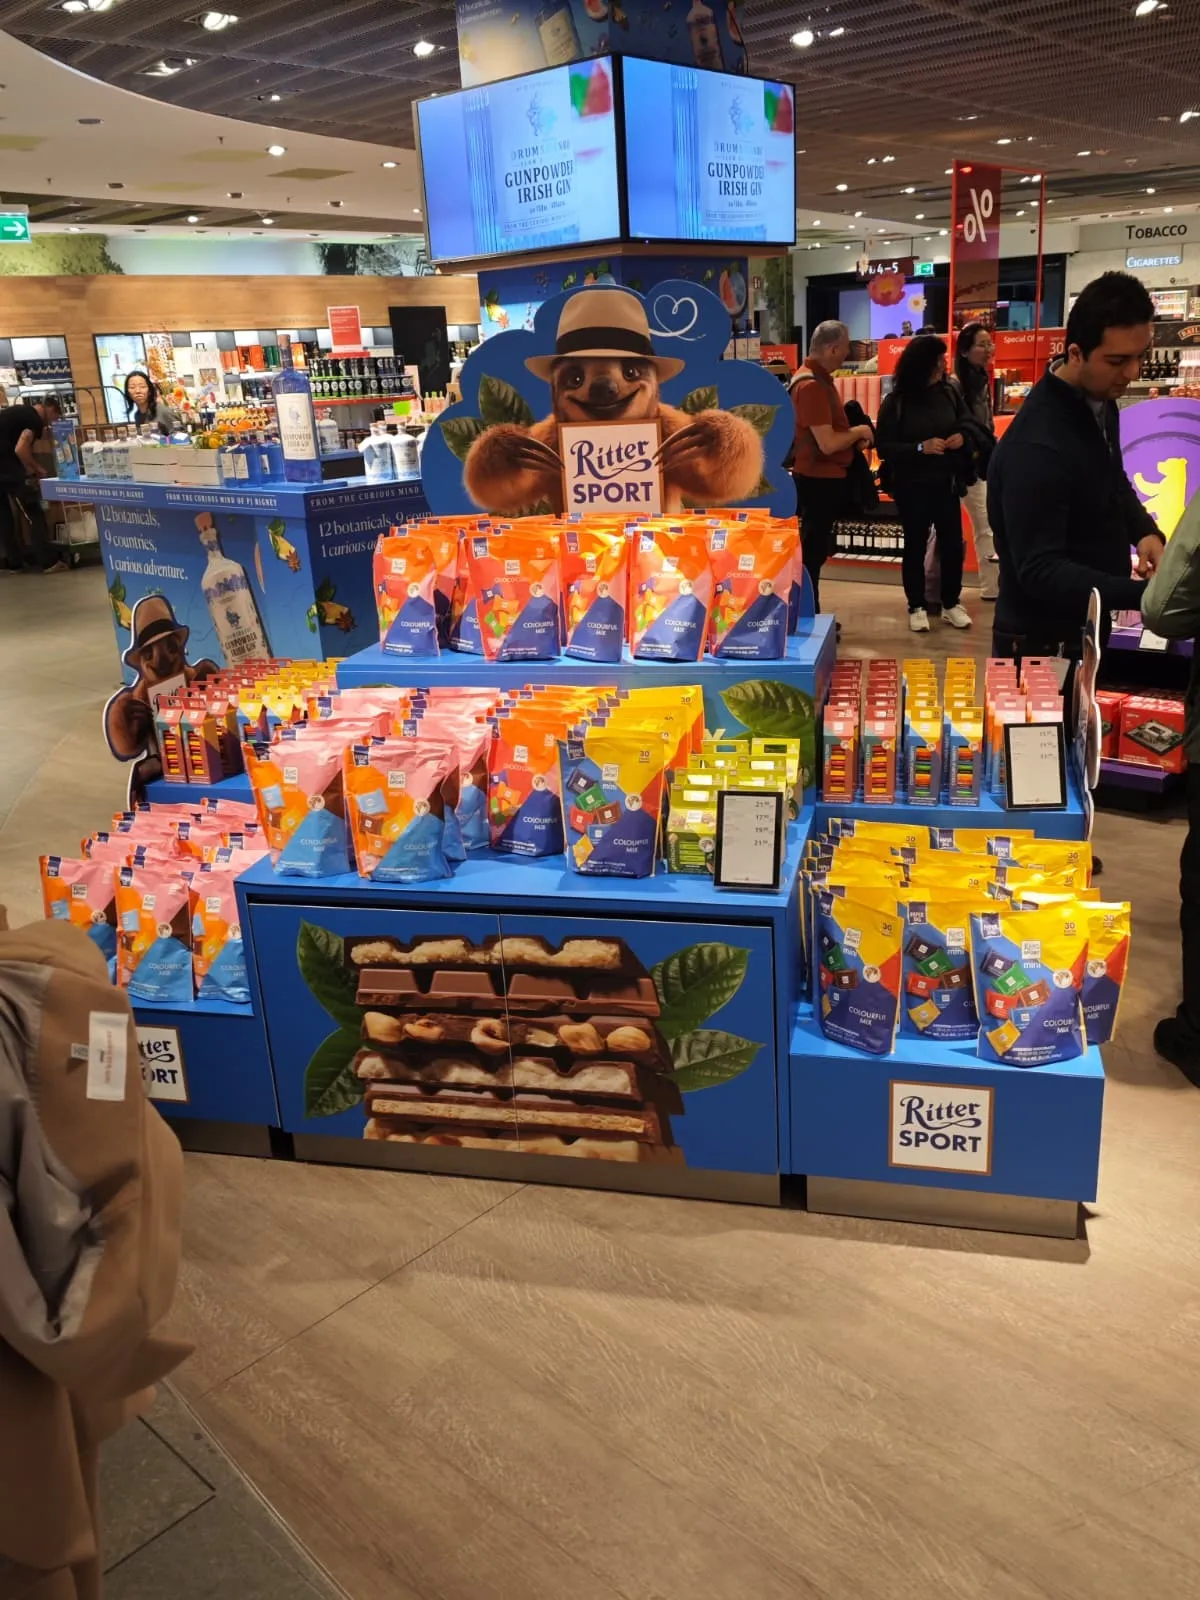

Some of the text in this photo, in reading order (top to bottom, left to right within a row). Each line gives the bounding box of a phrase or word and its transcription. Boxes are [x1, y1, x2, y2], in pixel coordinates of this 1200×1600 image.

[518, 182, 552, 204] IRISH
[719, 180, 747, 196] IRISH
[964, 188, 993, 243] %
[1004, 335, 1026, 345] Special
[570, 440, 652, 480] Ritter
[78, 488, 98, 496] CURIOUS
[165, 493, 180, 501] FROM
[182, 493, 193, 502] THE
[194, 494, 219, 503] CURIOUS
[220, 496, 235, 504] MIND
[246, 498, 253, 506] PJ
[254, 498, 277, 507] RIGNEY
[310, 487, 419, 507] FROM THE CURIOUS MIND
[573, 482, 653, 504] SPORT
[101, 505, 160, 528] 12 botanicals,
[319, 521, 331, 537] 12
[395, 512, 404, 524] 9
[104, 529, 157, 552] 9 countries,
[321, 540, 366, 558] 1 curious
[109, 554, 188, 580] 1 curious adventure.
[1103, 914, 1115, 922] 30
[1023, 961, 1041, 969] mini
[848, 1006, 887, 1021] COLOURFUL
[859, 1018, 872, 1026] MIX
[899, 1095, 982, 1131] Ritter
[899, 1130, 982, 1153] SPORT
